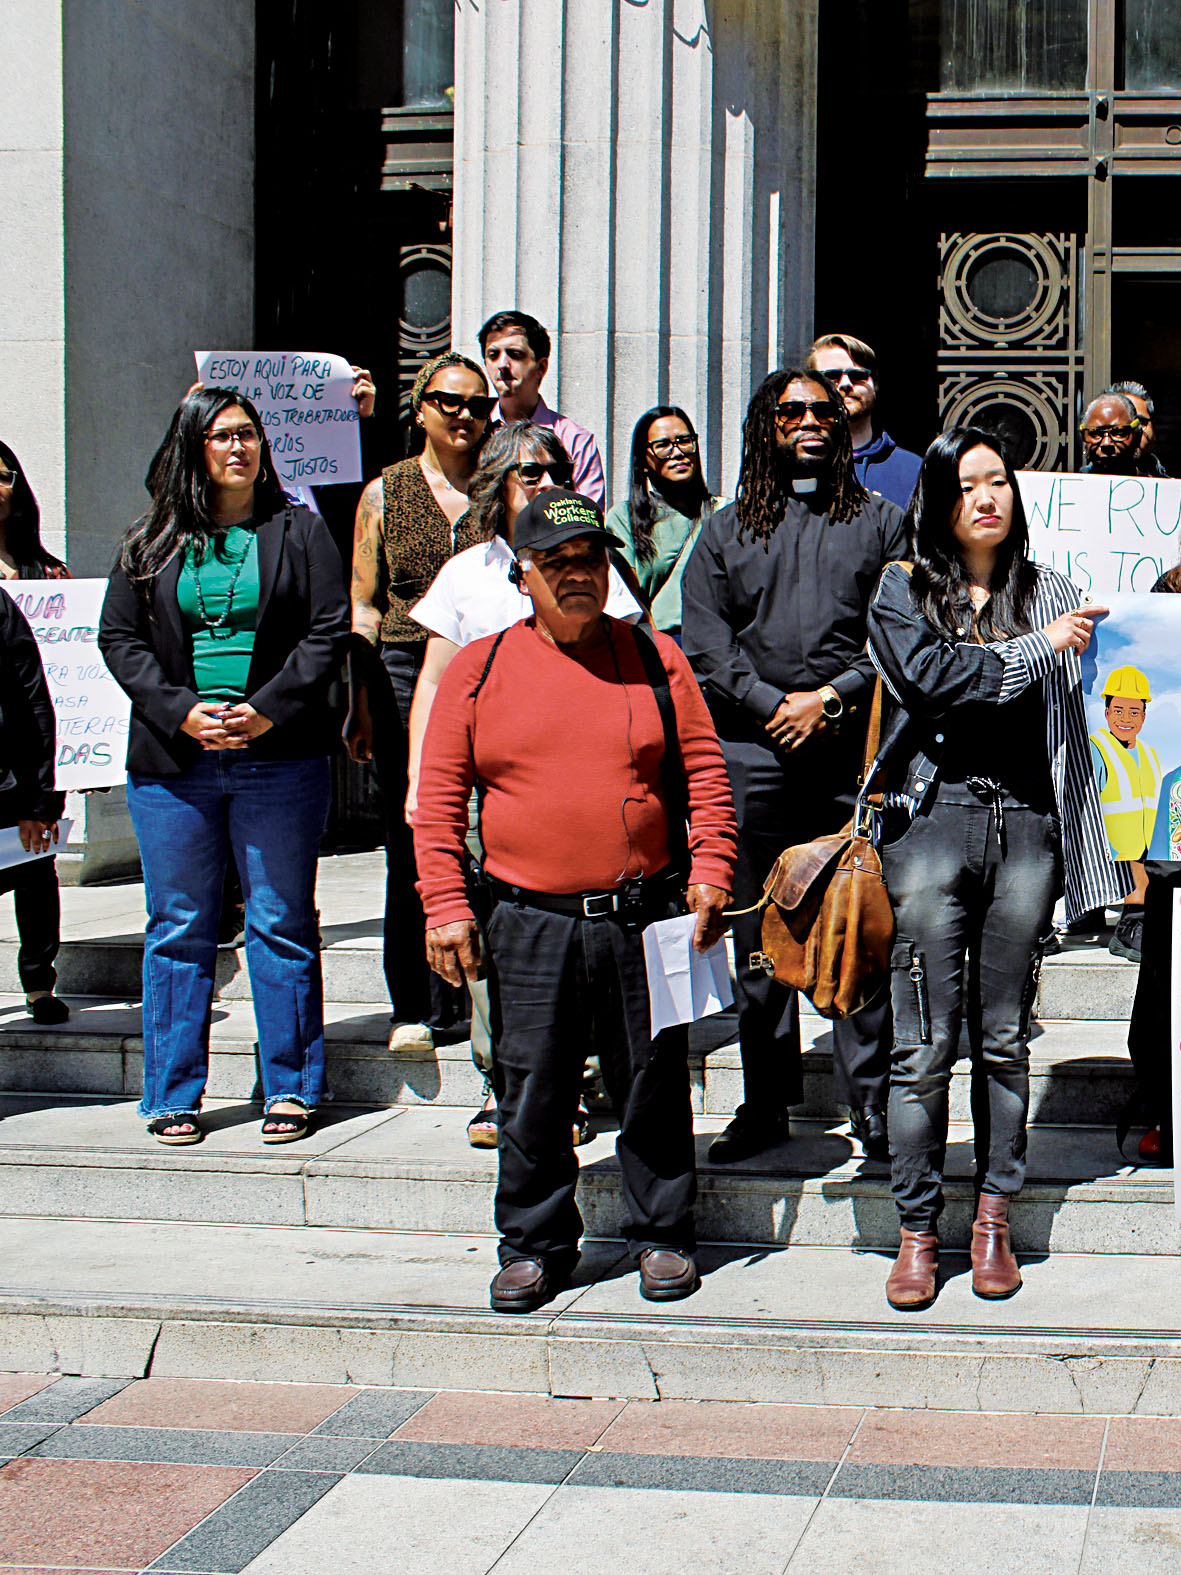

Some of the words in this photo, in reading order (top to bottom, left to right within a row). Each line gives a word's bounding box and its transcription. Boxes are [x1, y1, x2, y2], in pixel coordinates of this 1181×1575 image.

[209, 358, 250, 380] ESTOY
[291, 356, 332, 378] PARA
[245, 386, 263, 400] LA
[269, 383, 298, 400] VOZ
[302, 383, 325, 400] DE
[281, 456, 338, 482] JUSTOS
[1027, 478, 1084, 532] WE
